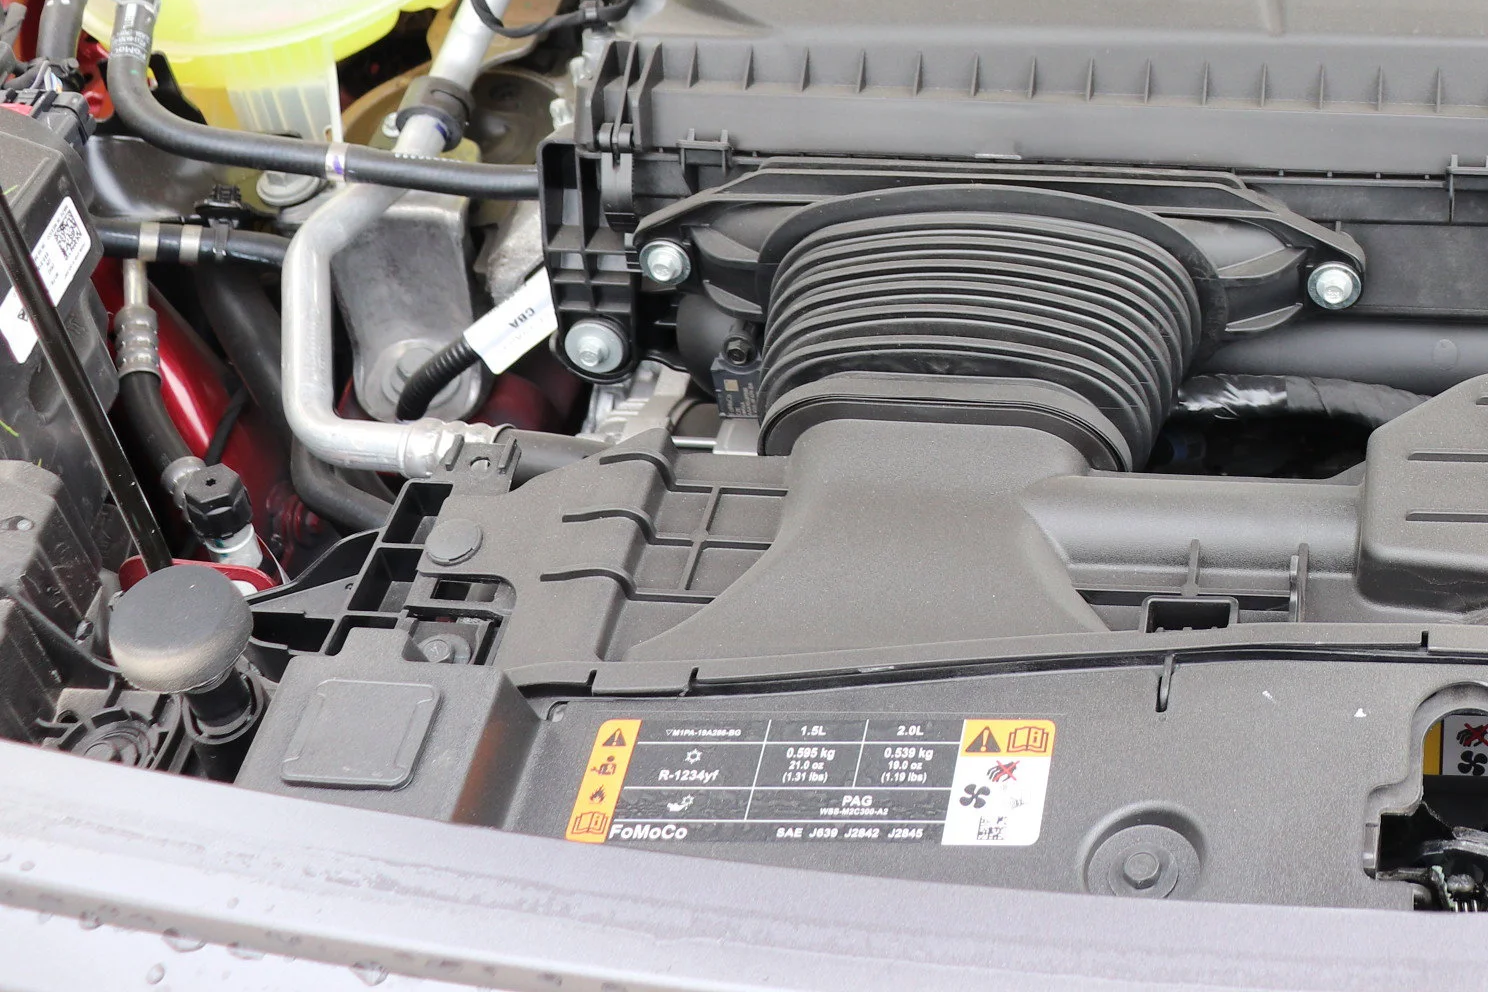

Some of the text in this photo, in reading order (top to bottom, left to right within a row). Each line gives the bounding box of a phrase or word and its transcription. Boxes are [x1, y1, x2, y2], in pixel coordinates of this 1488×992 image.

[800, 725, 827, 736] 1.5L
[896, 725, 924, 736] 2.0L
[786, 747, 836, 760] 0.595 kg
[884, 747, 934, 760] 0.539 kg
[788, 760, 825, 770] 21.0 oz
[888, 760, 923, 770] 19.0 oz
[658, 769, 720, 784] R-1234yf
[782, 771, 828, 783] (1.31 lbs)
[880, 771, 927, 783] (1.19 lbs)
[841, 795, 873, 807] PAG
[608, 824, 688, 840] FoMoCo
[776, 827, 924, 838] SAE J639 J2842 J2845
